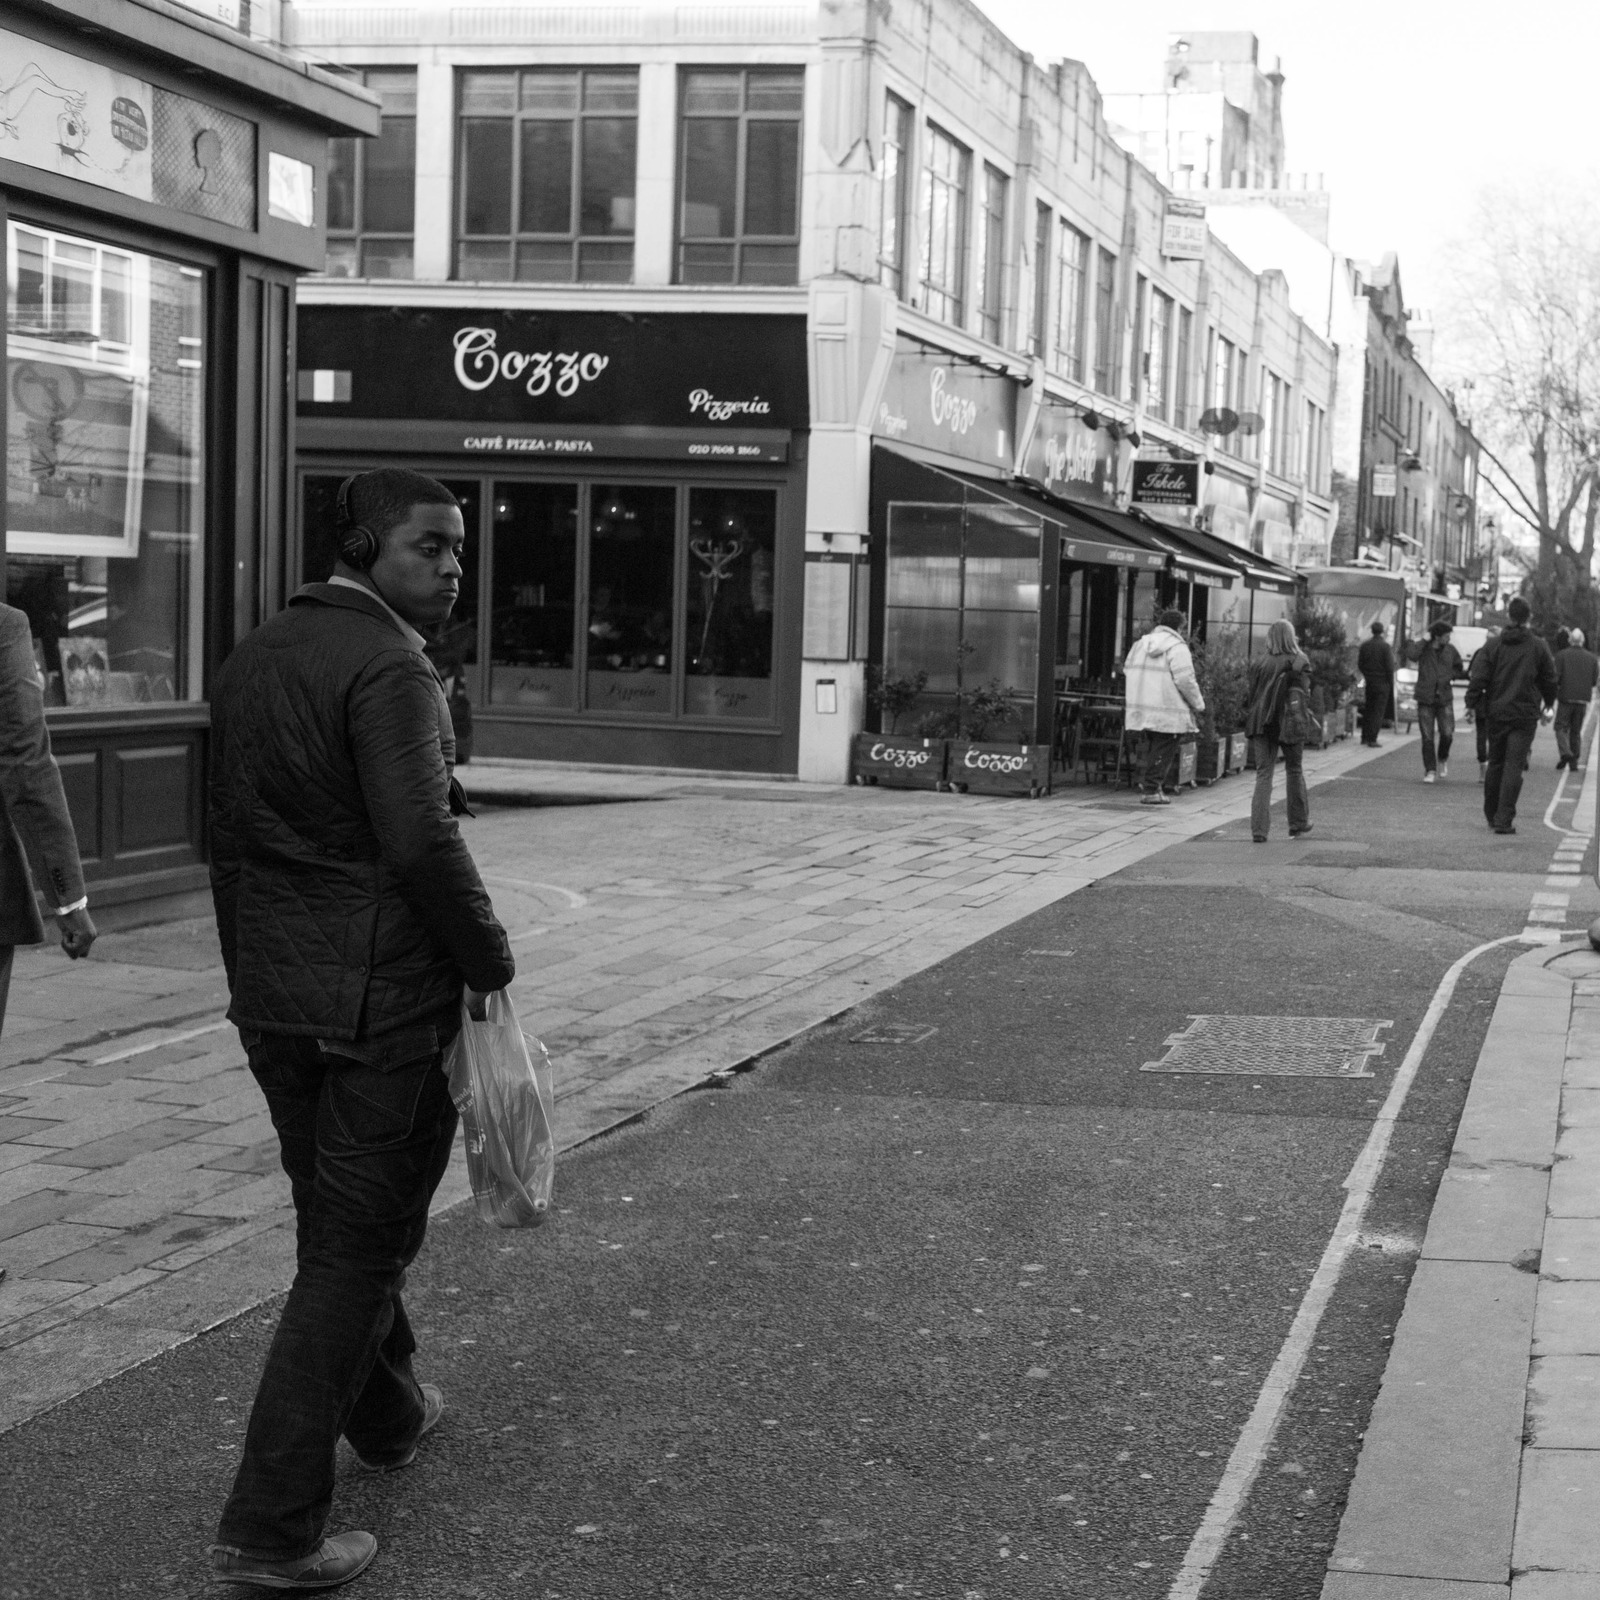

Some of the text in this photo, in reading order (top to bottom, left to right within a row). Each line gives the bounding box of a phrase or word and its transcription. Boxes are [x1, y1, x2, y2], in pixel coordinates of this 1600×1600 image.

[453, 326, 609, 397] Cozzo
[688, 388, 770, 420] Pizzeria
[930, 366, 977, 435] Cozzo
[506, 438, 546, 451] PIZZA
[554, 439, 594, 452] PASTA
[1155, 463, 1175, 473] The
[870, 742, 932, 768] Cozzo
[964, 745, 1028, 773] Cozzo
